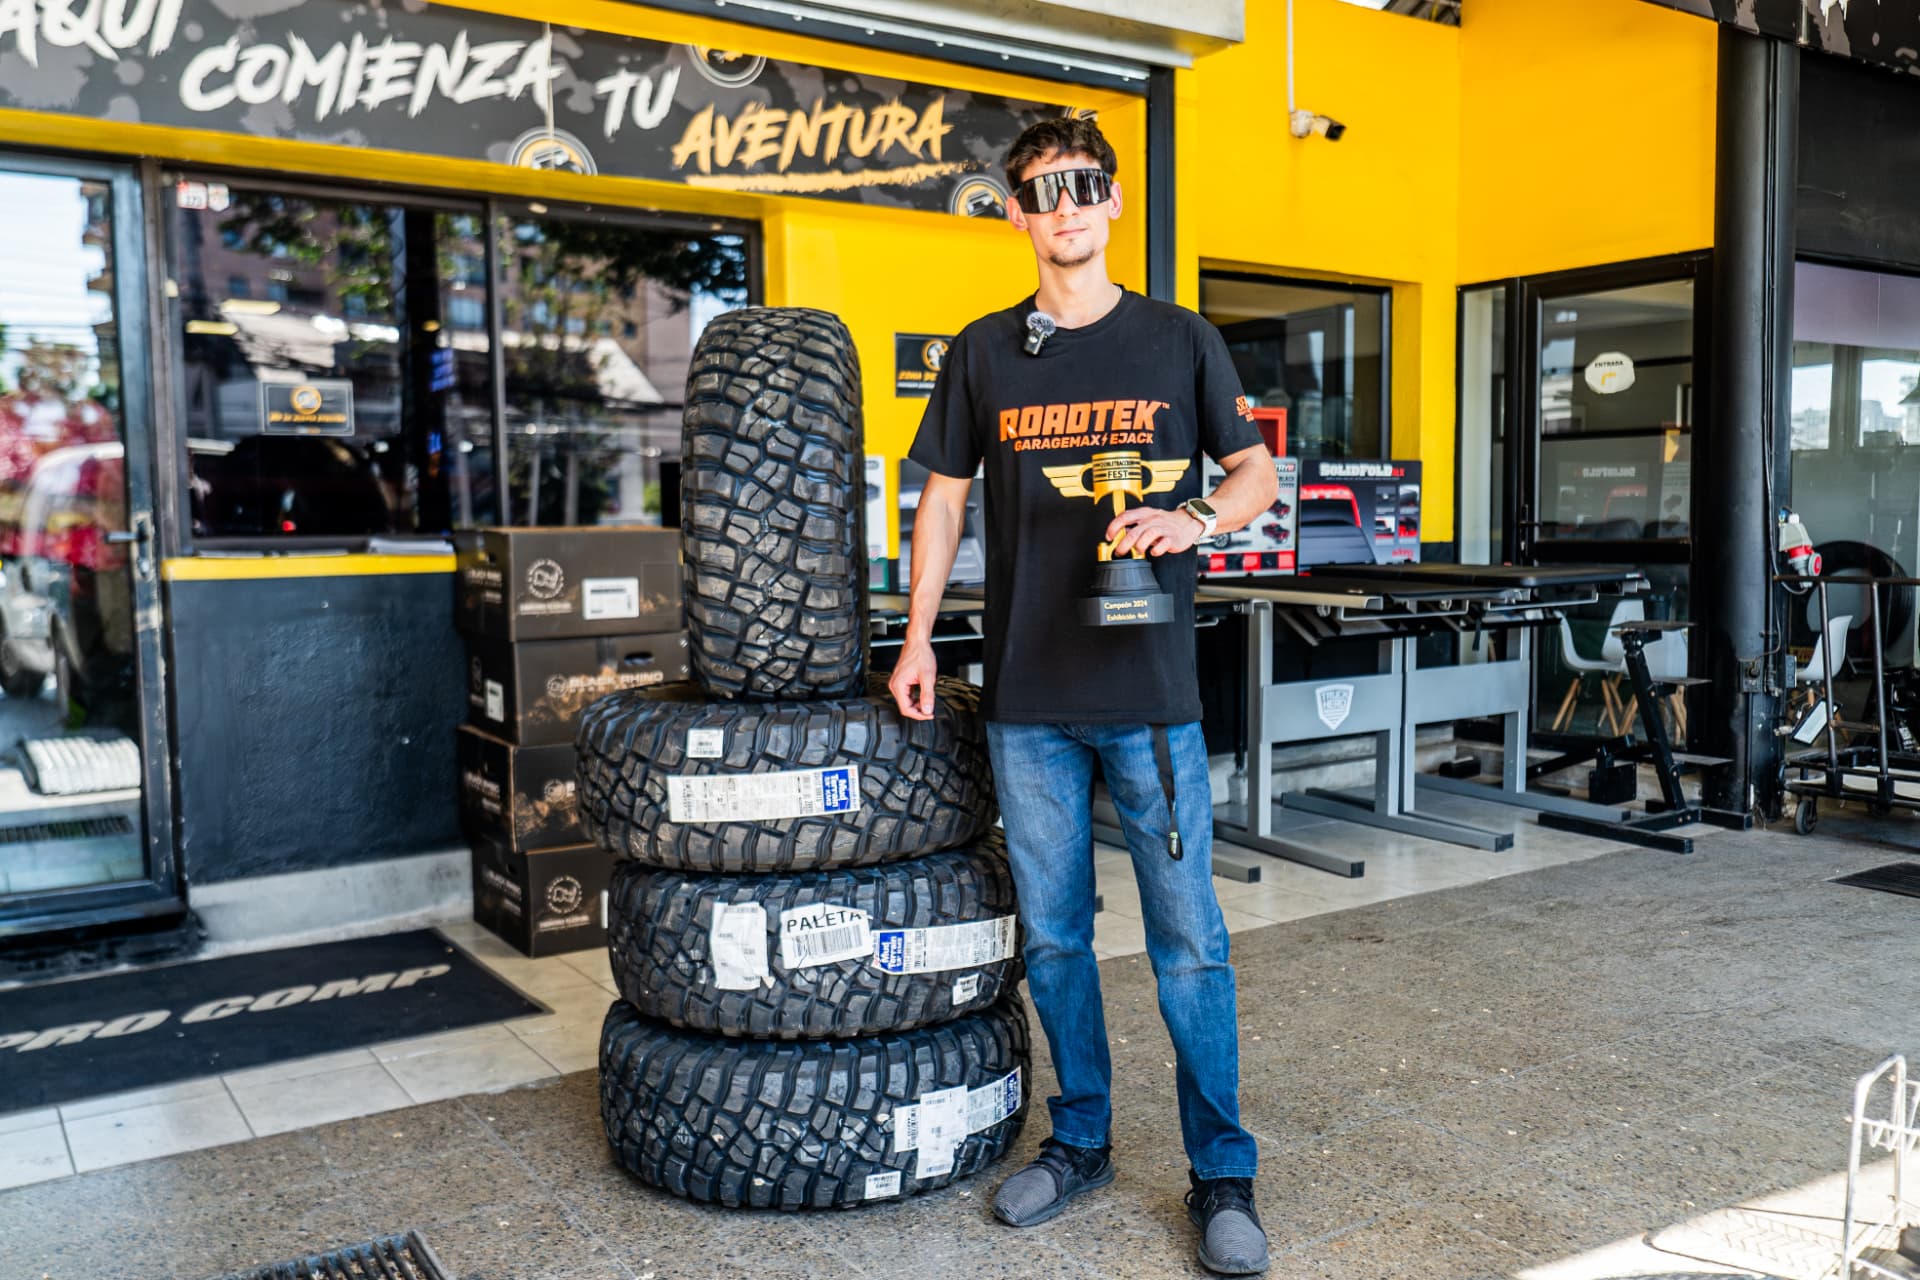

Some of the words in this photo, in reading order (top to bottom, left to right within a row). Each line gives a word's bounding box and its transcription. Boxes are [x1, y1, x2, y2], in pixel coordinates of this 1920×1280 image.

[179, 31, 564, 122] COMIENZA
[596, 66, 682, 138] TU
[671, 96, 954, 175] AVENTURA
[1594, 360, 1624, 368] ENTRADA
[999, 400, 1162, 442] ROADTEK
[1014, 435, 1101, 452] GARAGEMAX
[1110, 432, 1154, 445] EJACK
[1107, 470, 1128, 479] FEST
[786, 910, 863, 933] PALETA
[181, 964, 451, 1024] COMP
